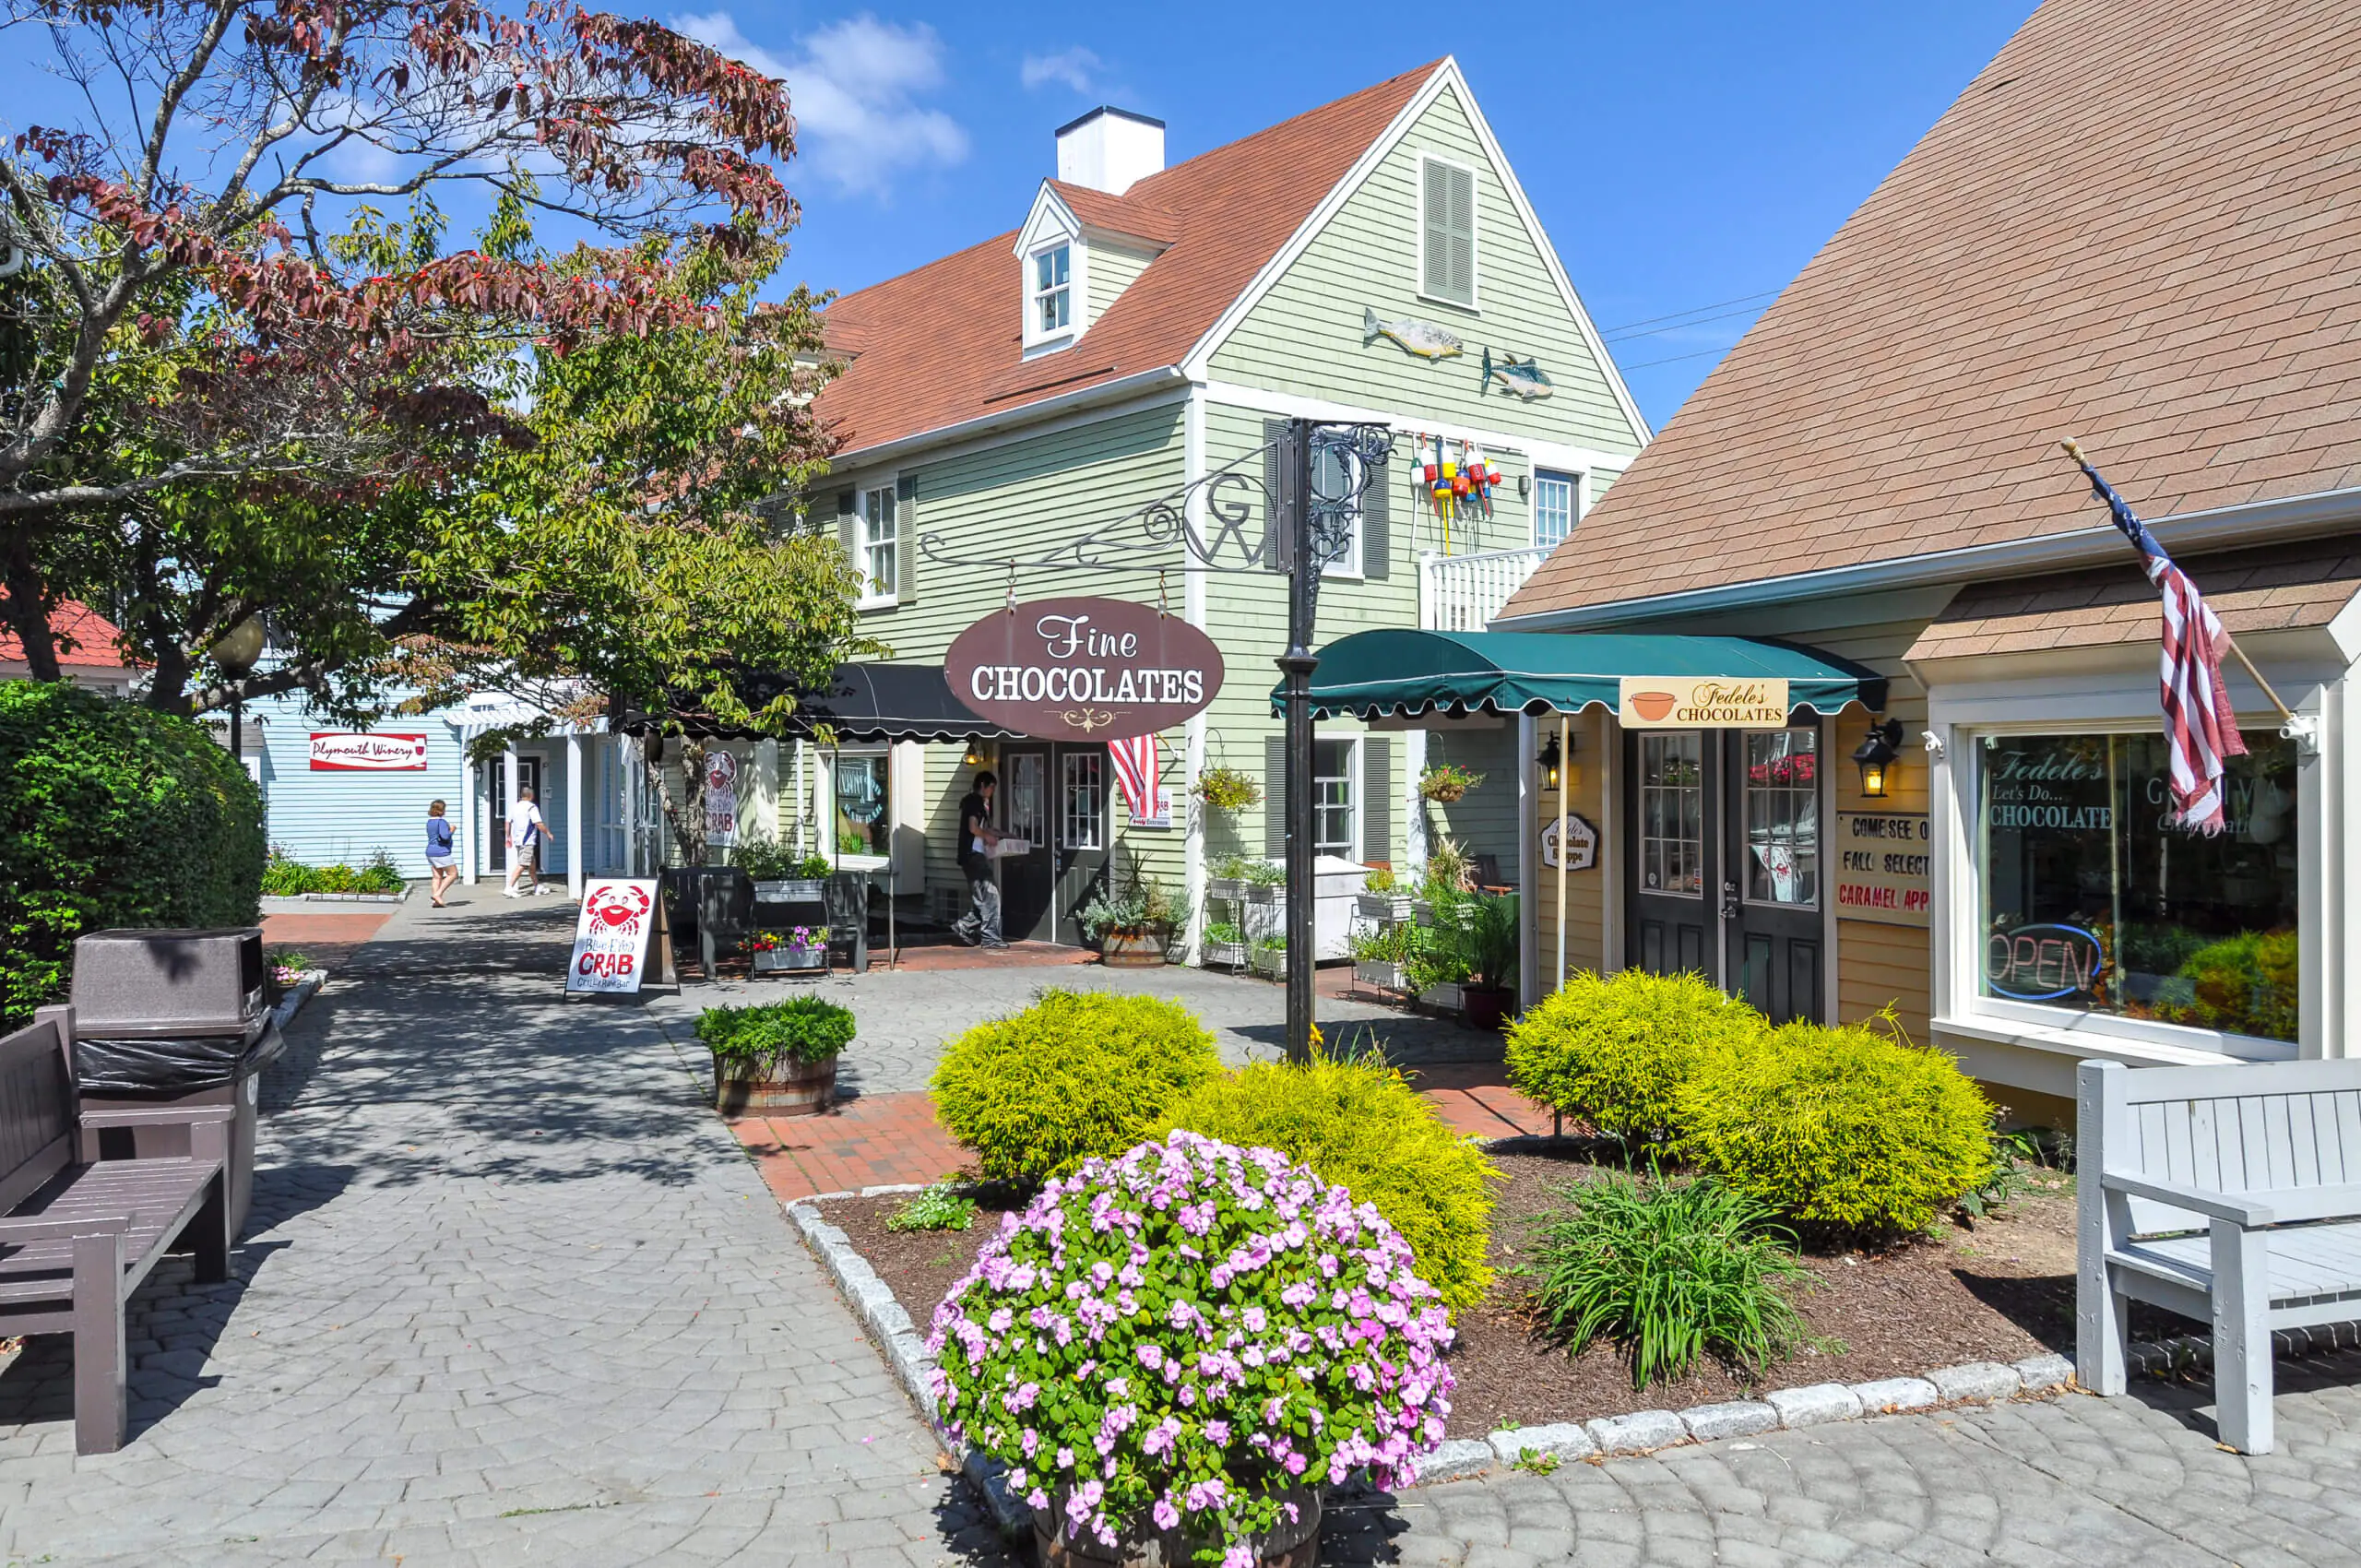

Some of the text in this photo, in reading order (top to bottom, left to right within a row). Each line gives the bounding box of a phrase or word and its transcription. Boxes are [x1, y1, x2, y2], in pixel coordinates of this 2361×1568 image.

[1036, 614, 1138, 659] Fine
[970, 664, 1204, 705] CHOCOLATES
[1691, 683, 1769, 707] Fedele's
[1677, 707, 1782, 721] CHOCOLATES
[313, 741, 413, 760] Plymouth Winery
[1991, 750, 2106, 780] Fedele's
[1992, 784, 2063, 802] Let's Do...
[2146, 778, 2283, 805] GIVA
[1852, 817, 1886, 838] COME
[1888, 819, 1913, 840] SEE
[1990, 804, 2113, 829] CHOCOLATE
[1548, 834, 1589, 849] Cholate
[1844, 850, 1874, 872] FALL
[1839, 884, 1897, 909] CARAMEL
[578, 952, 634, 978] CRAB
[1987, 933, 2093, 991] OPEN
